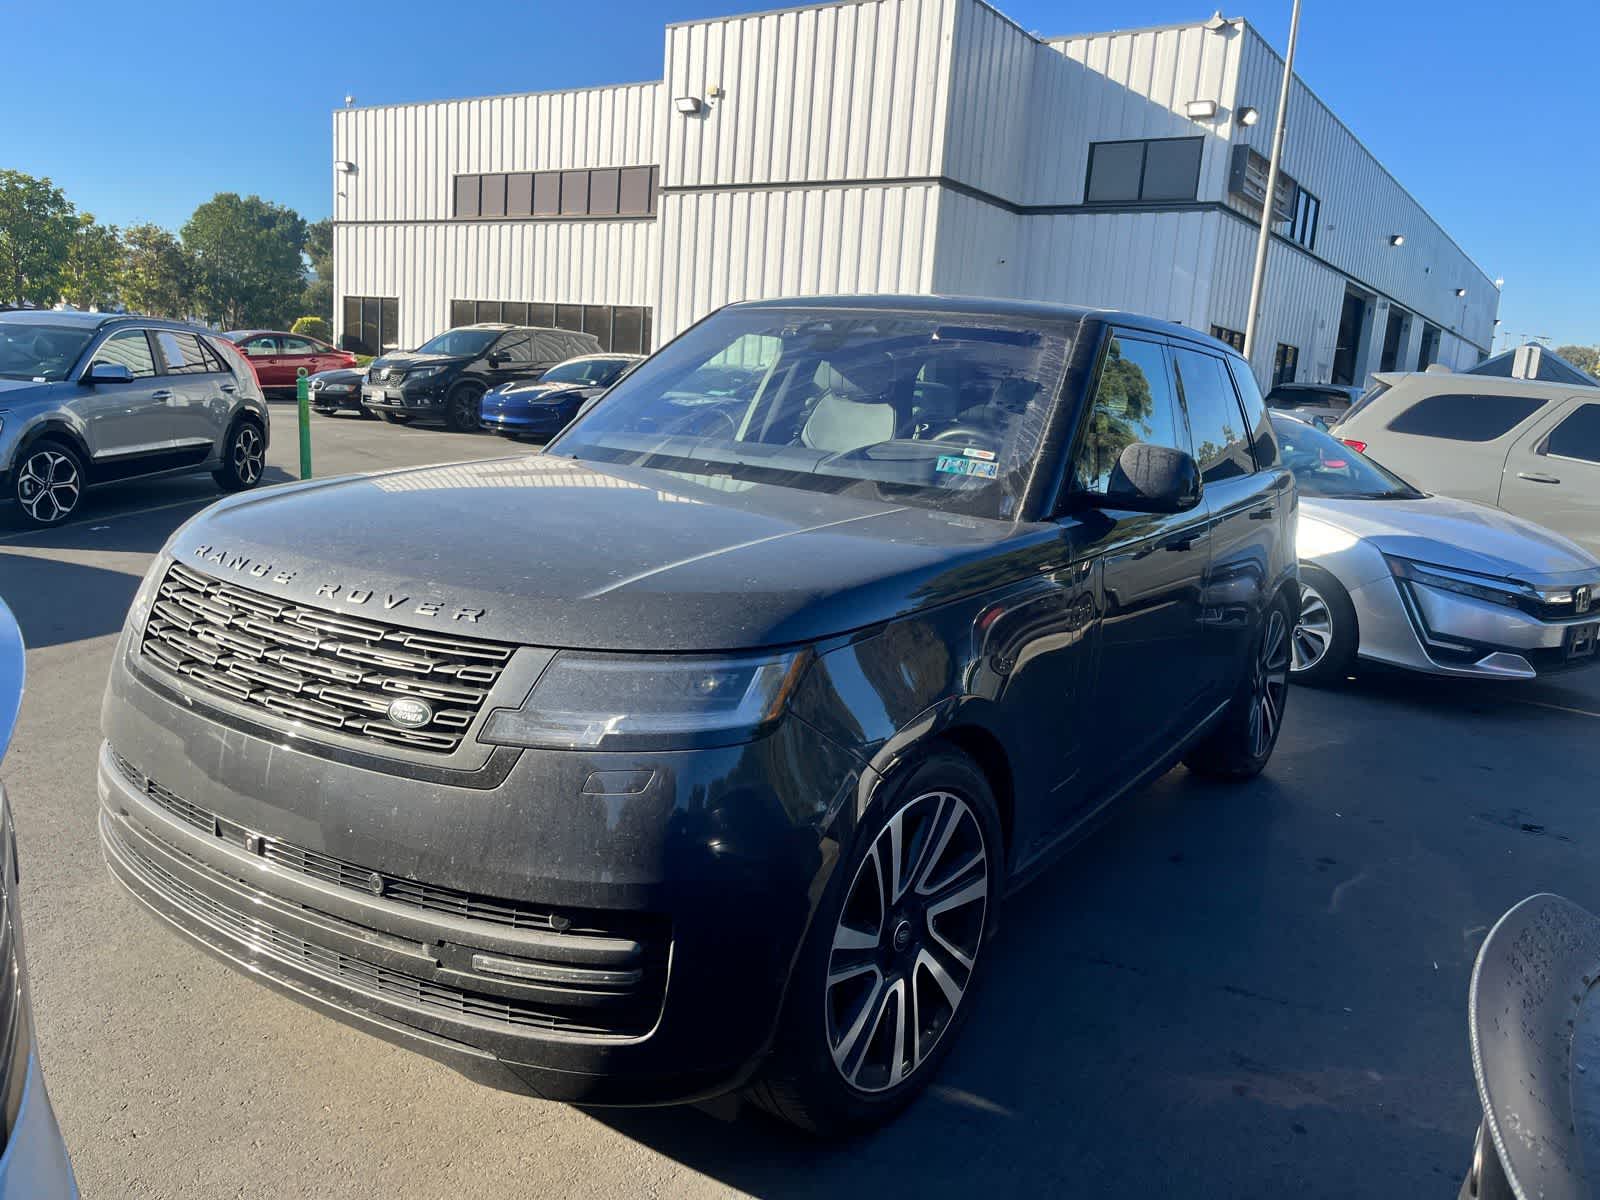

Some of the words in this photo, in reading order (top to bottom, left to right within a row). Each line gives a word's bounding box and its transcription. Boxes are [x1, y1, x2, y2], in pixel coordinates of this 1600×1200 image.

[194, 544, 297, 585] RANGE
[315, 583, 486, 624] ROVER
[397, 711, 423, 722] ROVER
